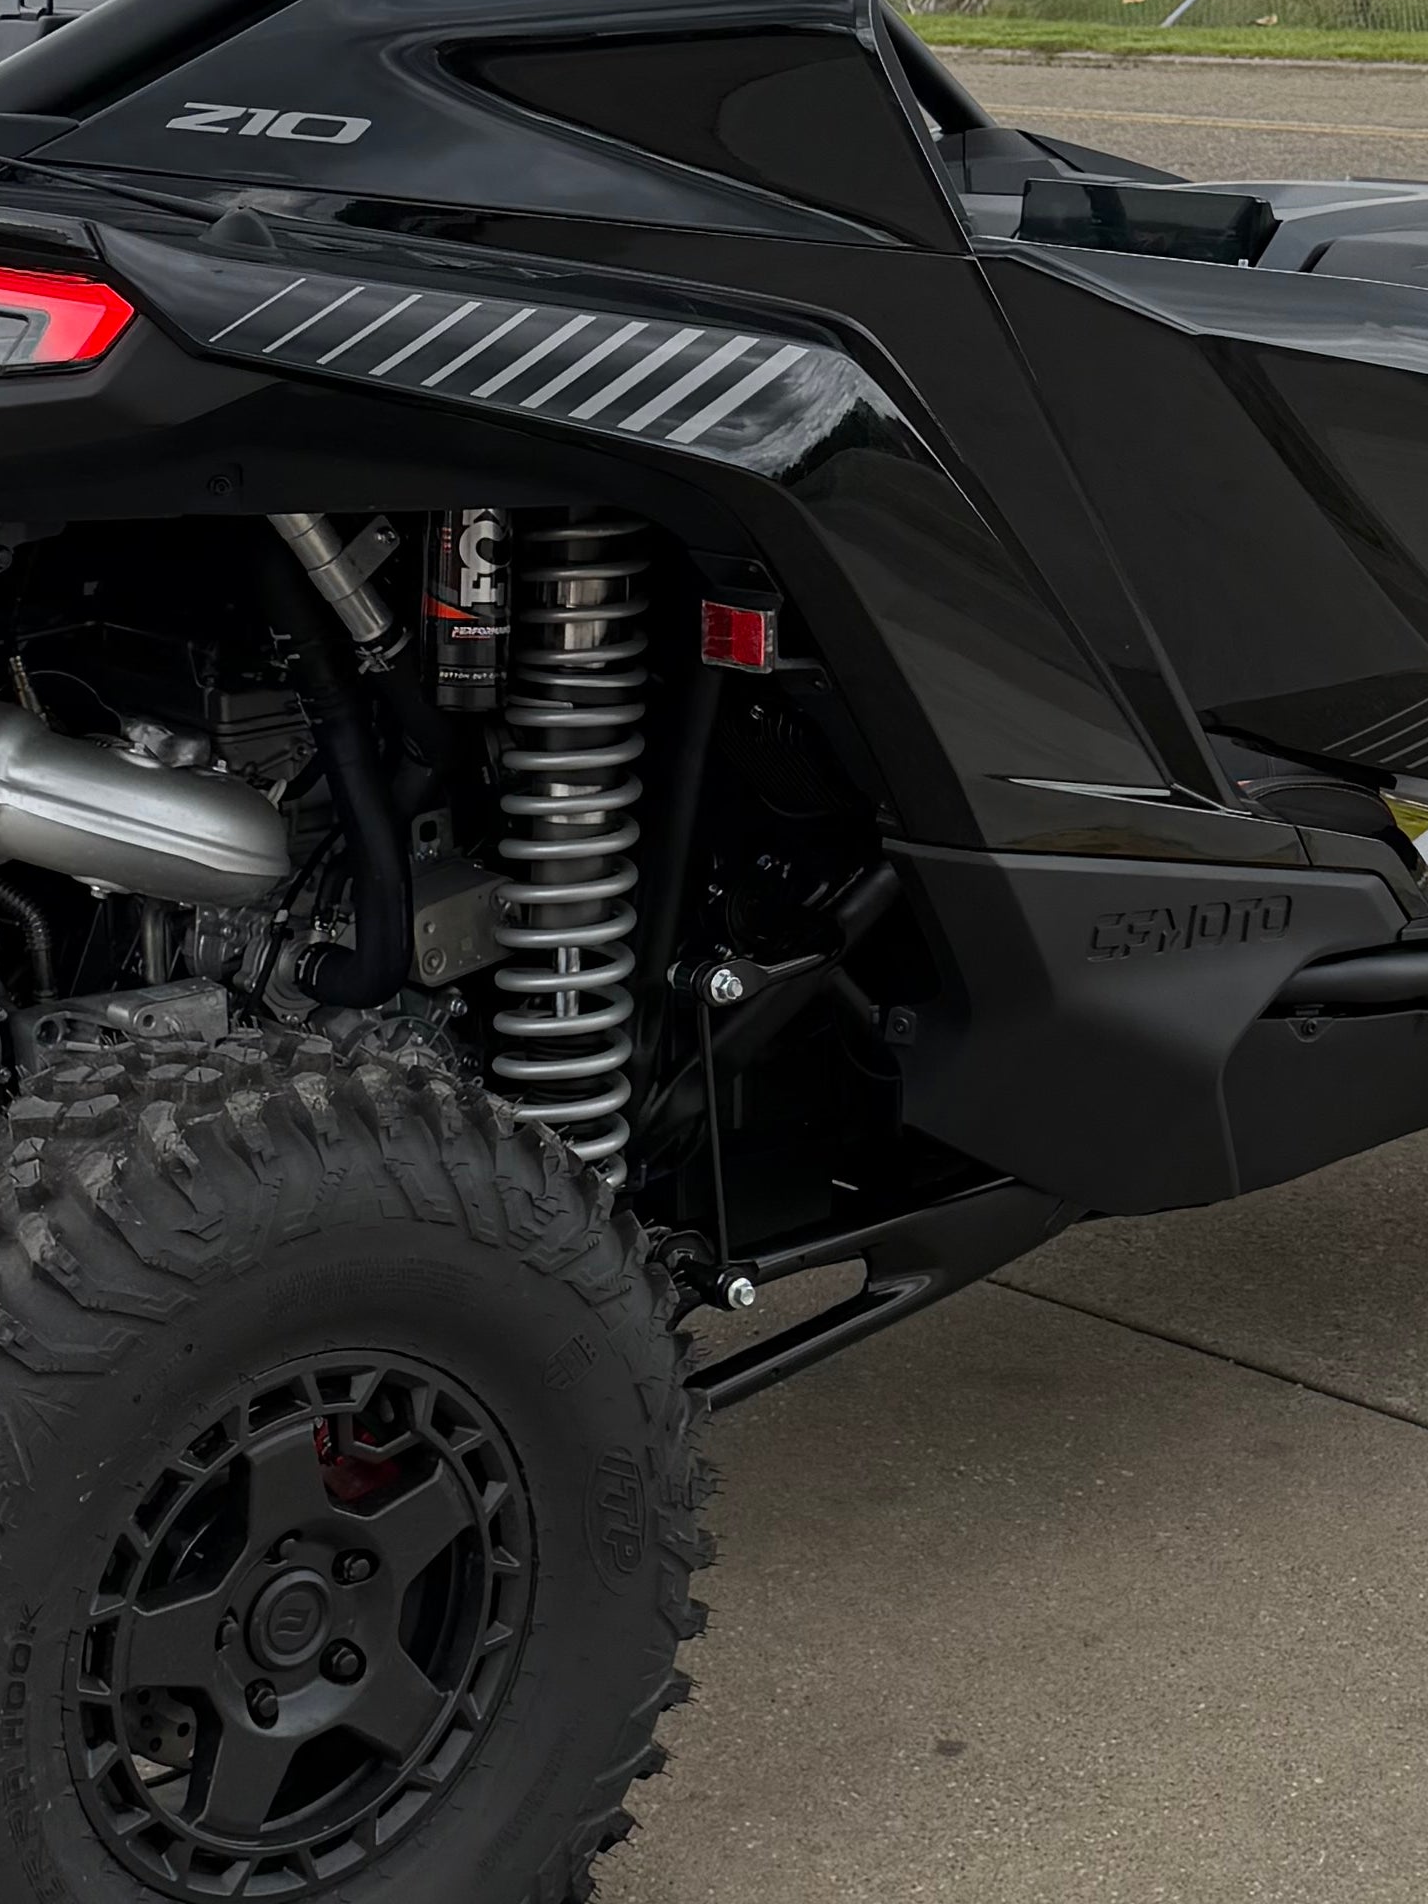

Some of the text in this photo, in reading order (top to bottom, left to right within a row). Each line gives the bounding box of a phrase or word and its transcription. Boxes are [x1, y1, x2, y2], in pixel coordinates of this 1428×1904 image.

[166, 102, 372, 144] Z10
[1086, 895, 1293, 963] CFMOTO
[598, 1453, 642, 1574] ITP
